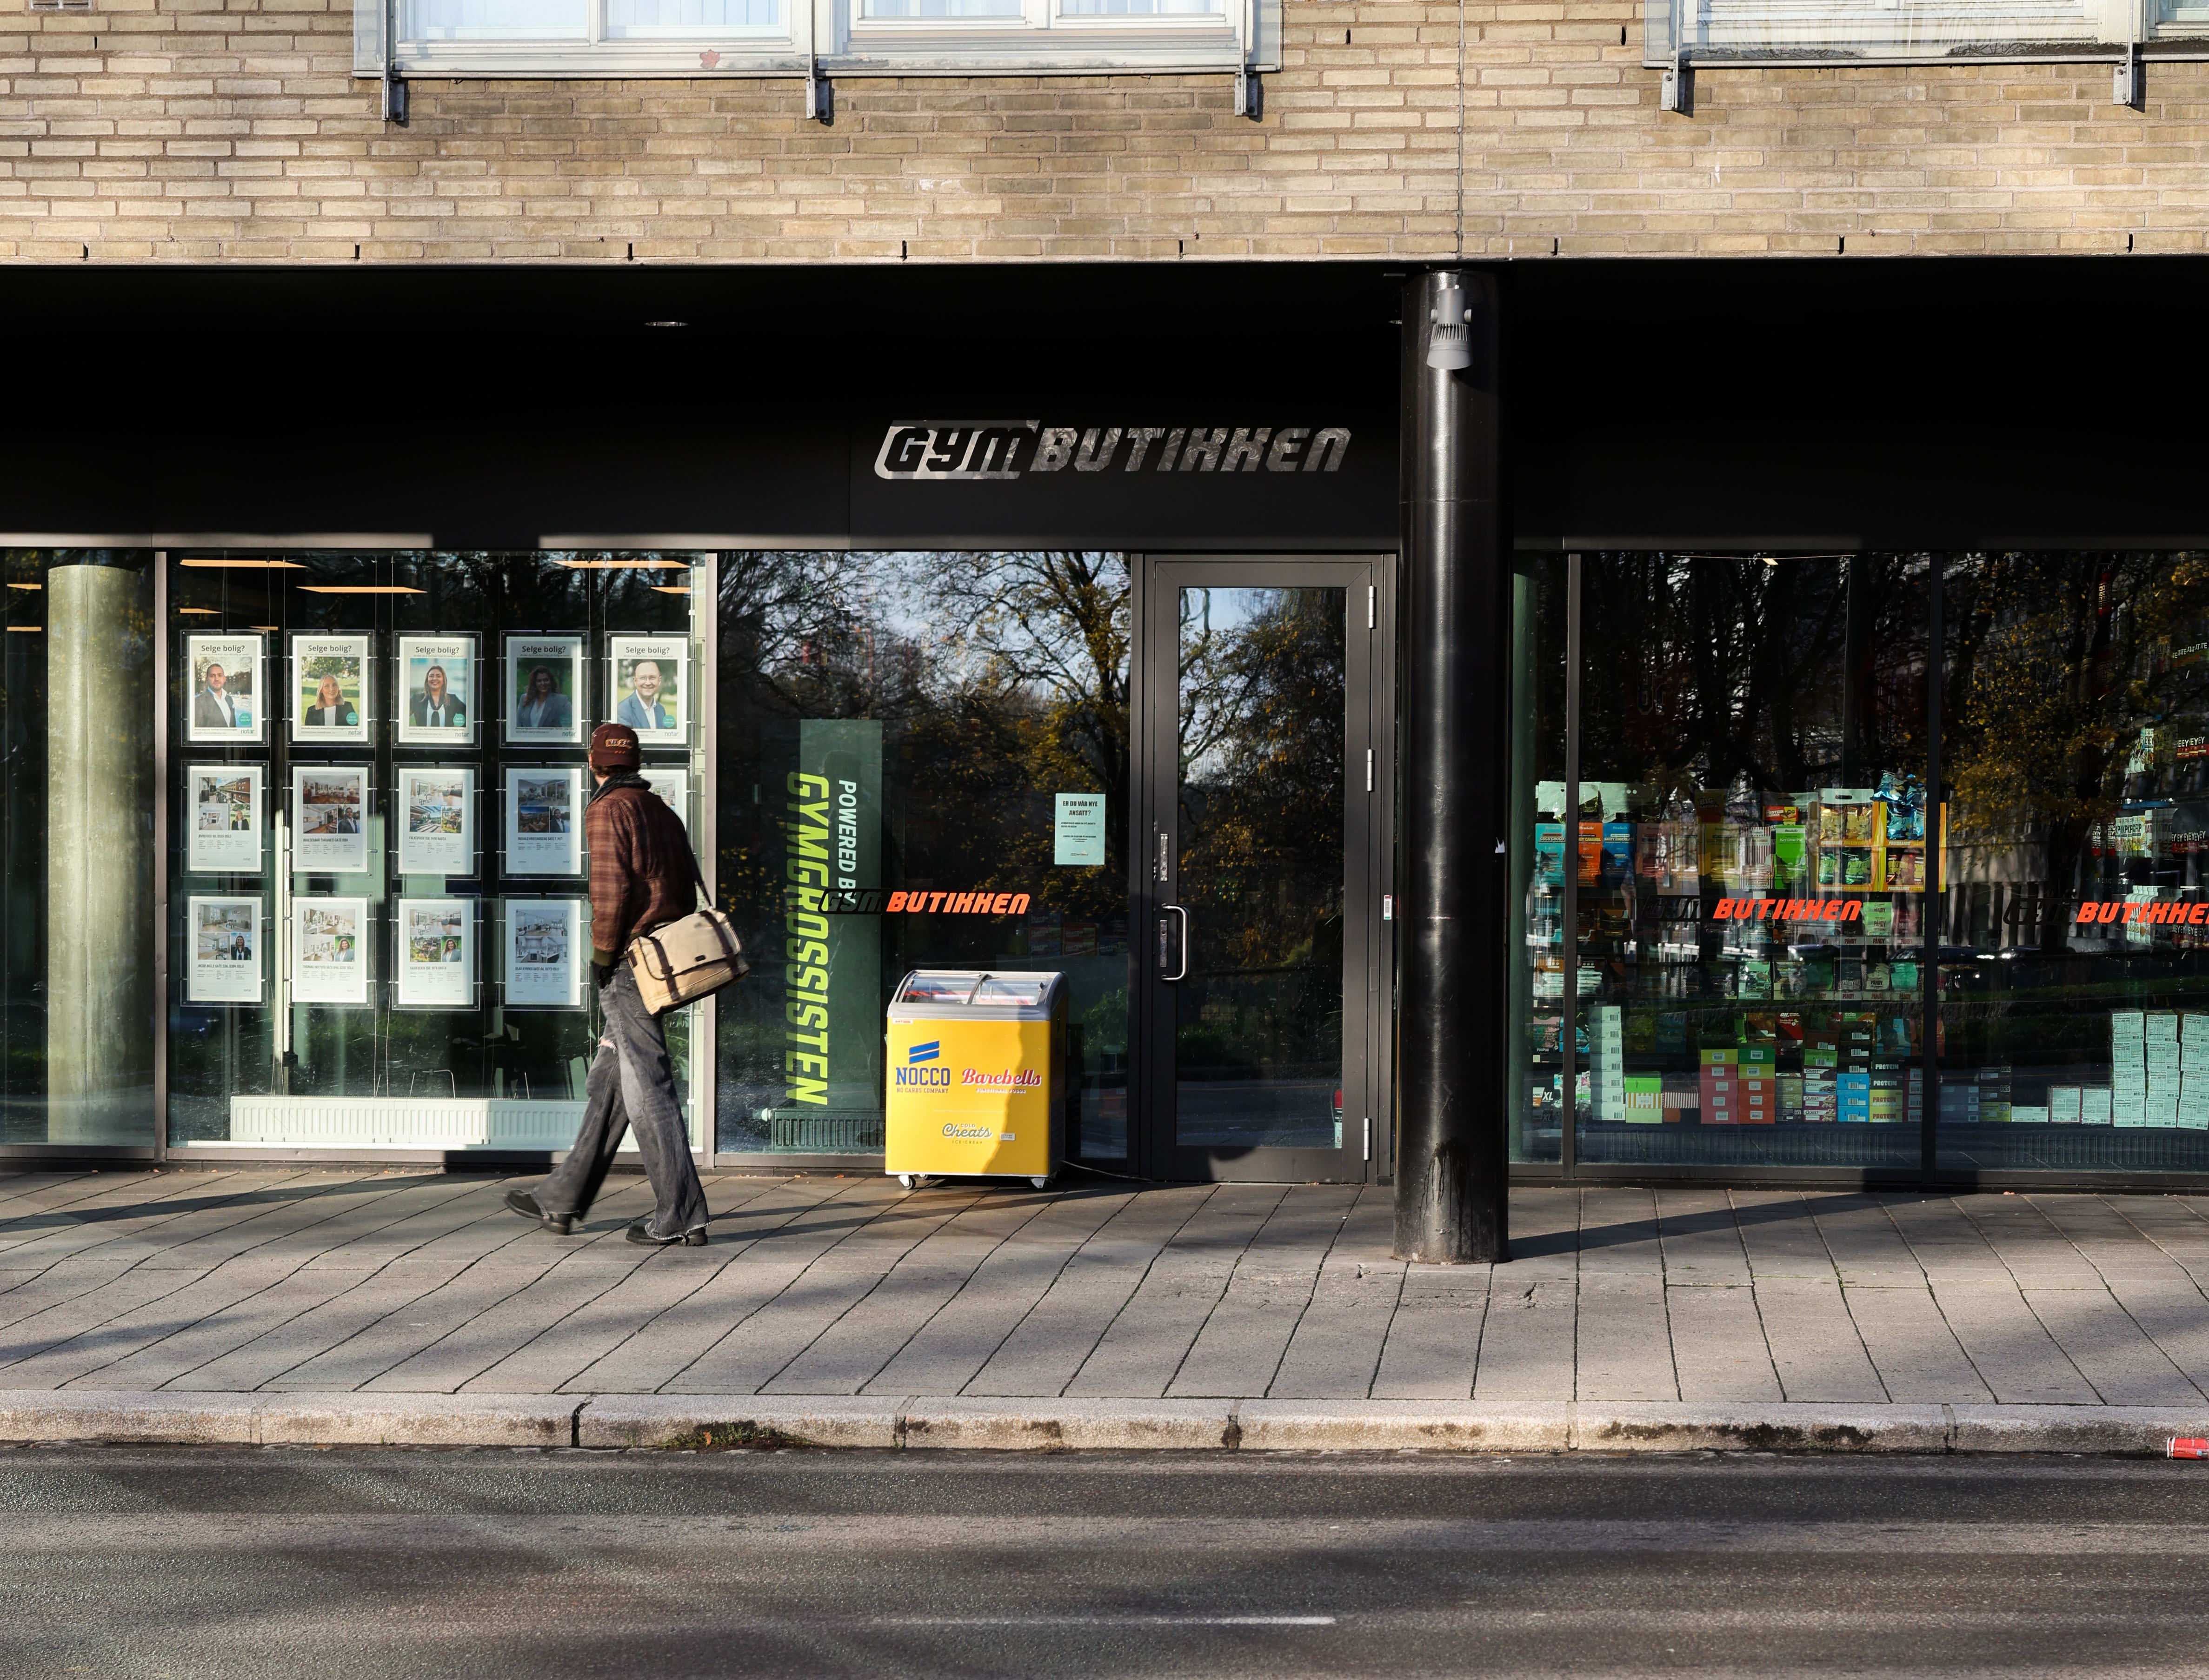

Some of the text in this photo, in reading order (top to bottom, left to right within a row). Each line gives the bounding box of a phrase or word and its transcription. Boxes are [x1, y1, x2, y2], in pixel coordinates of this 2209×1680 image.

[838, 780, 857, 872] POWERED
[2076, 902, 2209, 923] BUTIKKE
[786, 772, 829, 1105] GYMGROSSISTEN
[896, 1067, 950, 1086] NOCCO
[961, 1068, 1042, 1086] Barebells
[1542, 1091, 1553, 1101] XL
[942, 1122, 992, 1139] Cheats
